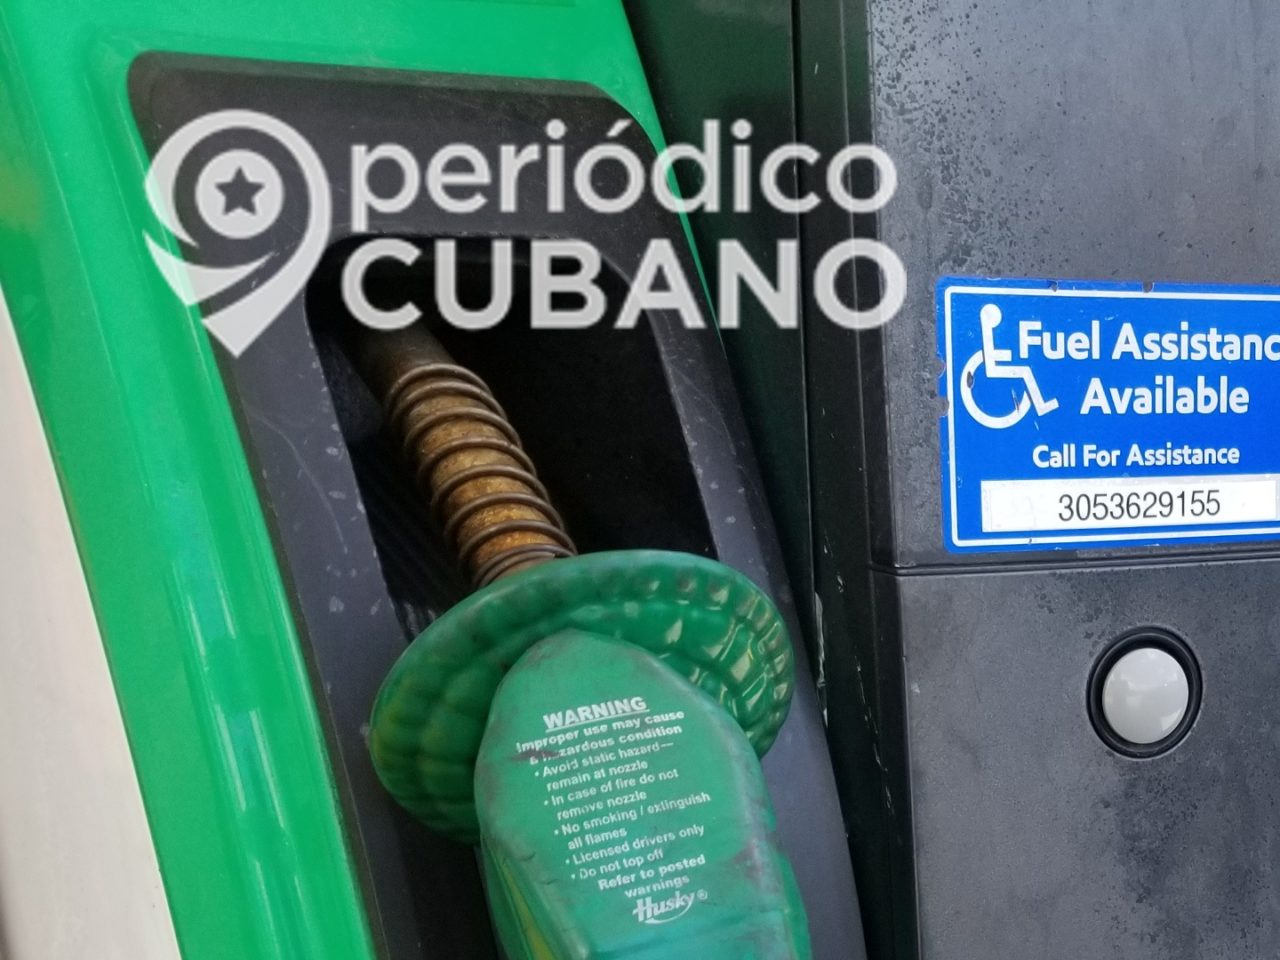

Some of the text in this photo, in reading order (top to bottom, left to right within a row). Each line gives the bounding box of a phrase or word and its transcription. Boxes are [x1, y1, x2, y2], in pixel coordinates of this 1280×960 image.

[1018, 319, 1100, 359] Fuel
[1080, 376, 1249, 414] Available
[1032, 442, 1240, 468] Call For Assistance
[1058, 489, 1221, 521] 3053629155
[543, 696, 647, 730] WARNING
[516, 710, 685, 753] Improper use may cause
[542, 737, 615, 762] zardous
[619, 724, 683, 744] condition
[543, 759, 579, 777] Avoid
[582, 752, 616, 767] static
[547, 760, 648, 792] remain at nozzle
[552, 768, 679, 806] In case of fire do not
[557, 790, 647, 821] remove nozzle
[561, 823, 580, 836] No
[583, 809, 637, 829] smoking
[647, 792, 711, 814] extinguish
[568, 827, 627, 851] all flames
[572, 824, 704, 865] Licensed drivers only
[579, 848, 664, 879] Do not top off
[598, 854, 705, 891] Refer to posted
[624, 875, 690, 899] warnings
